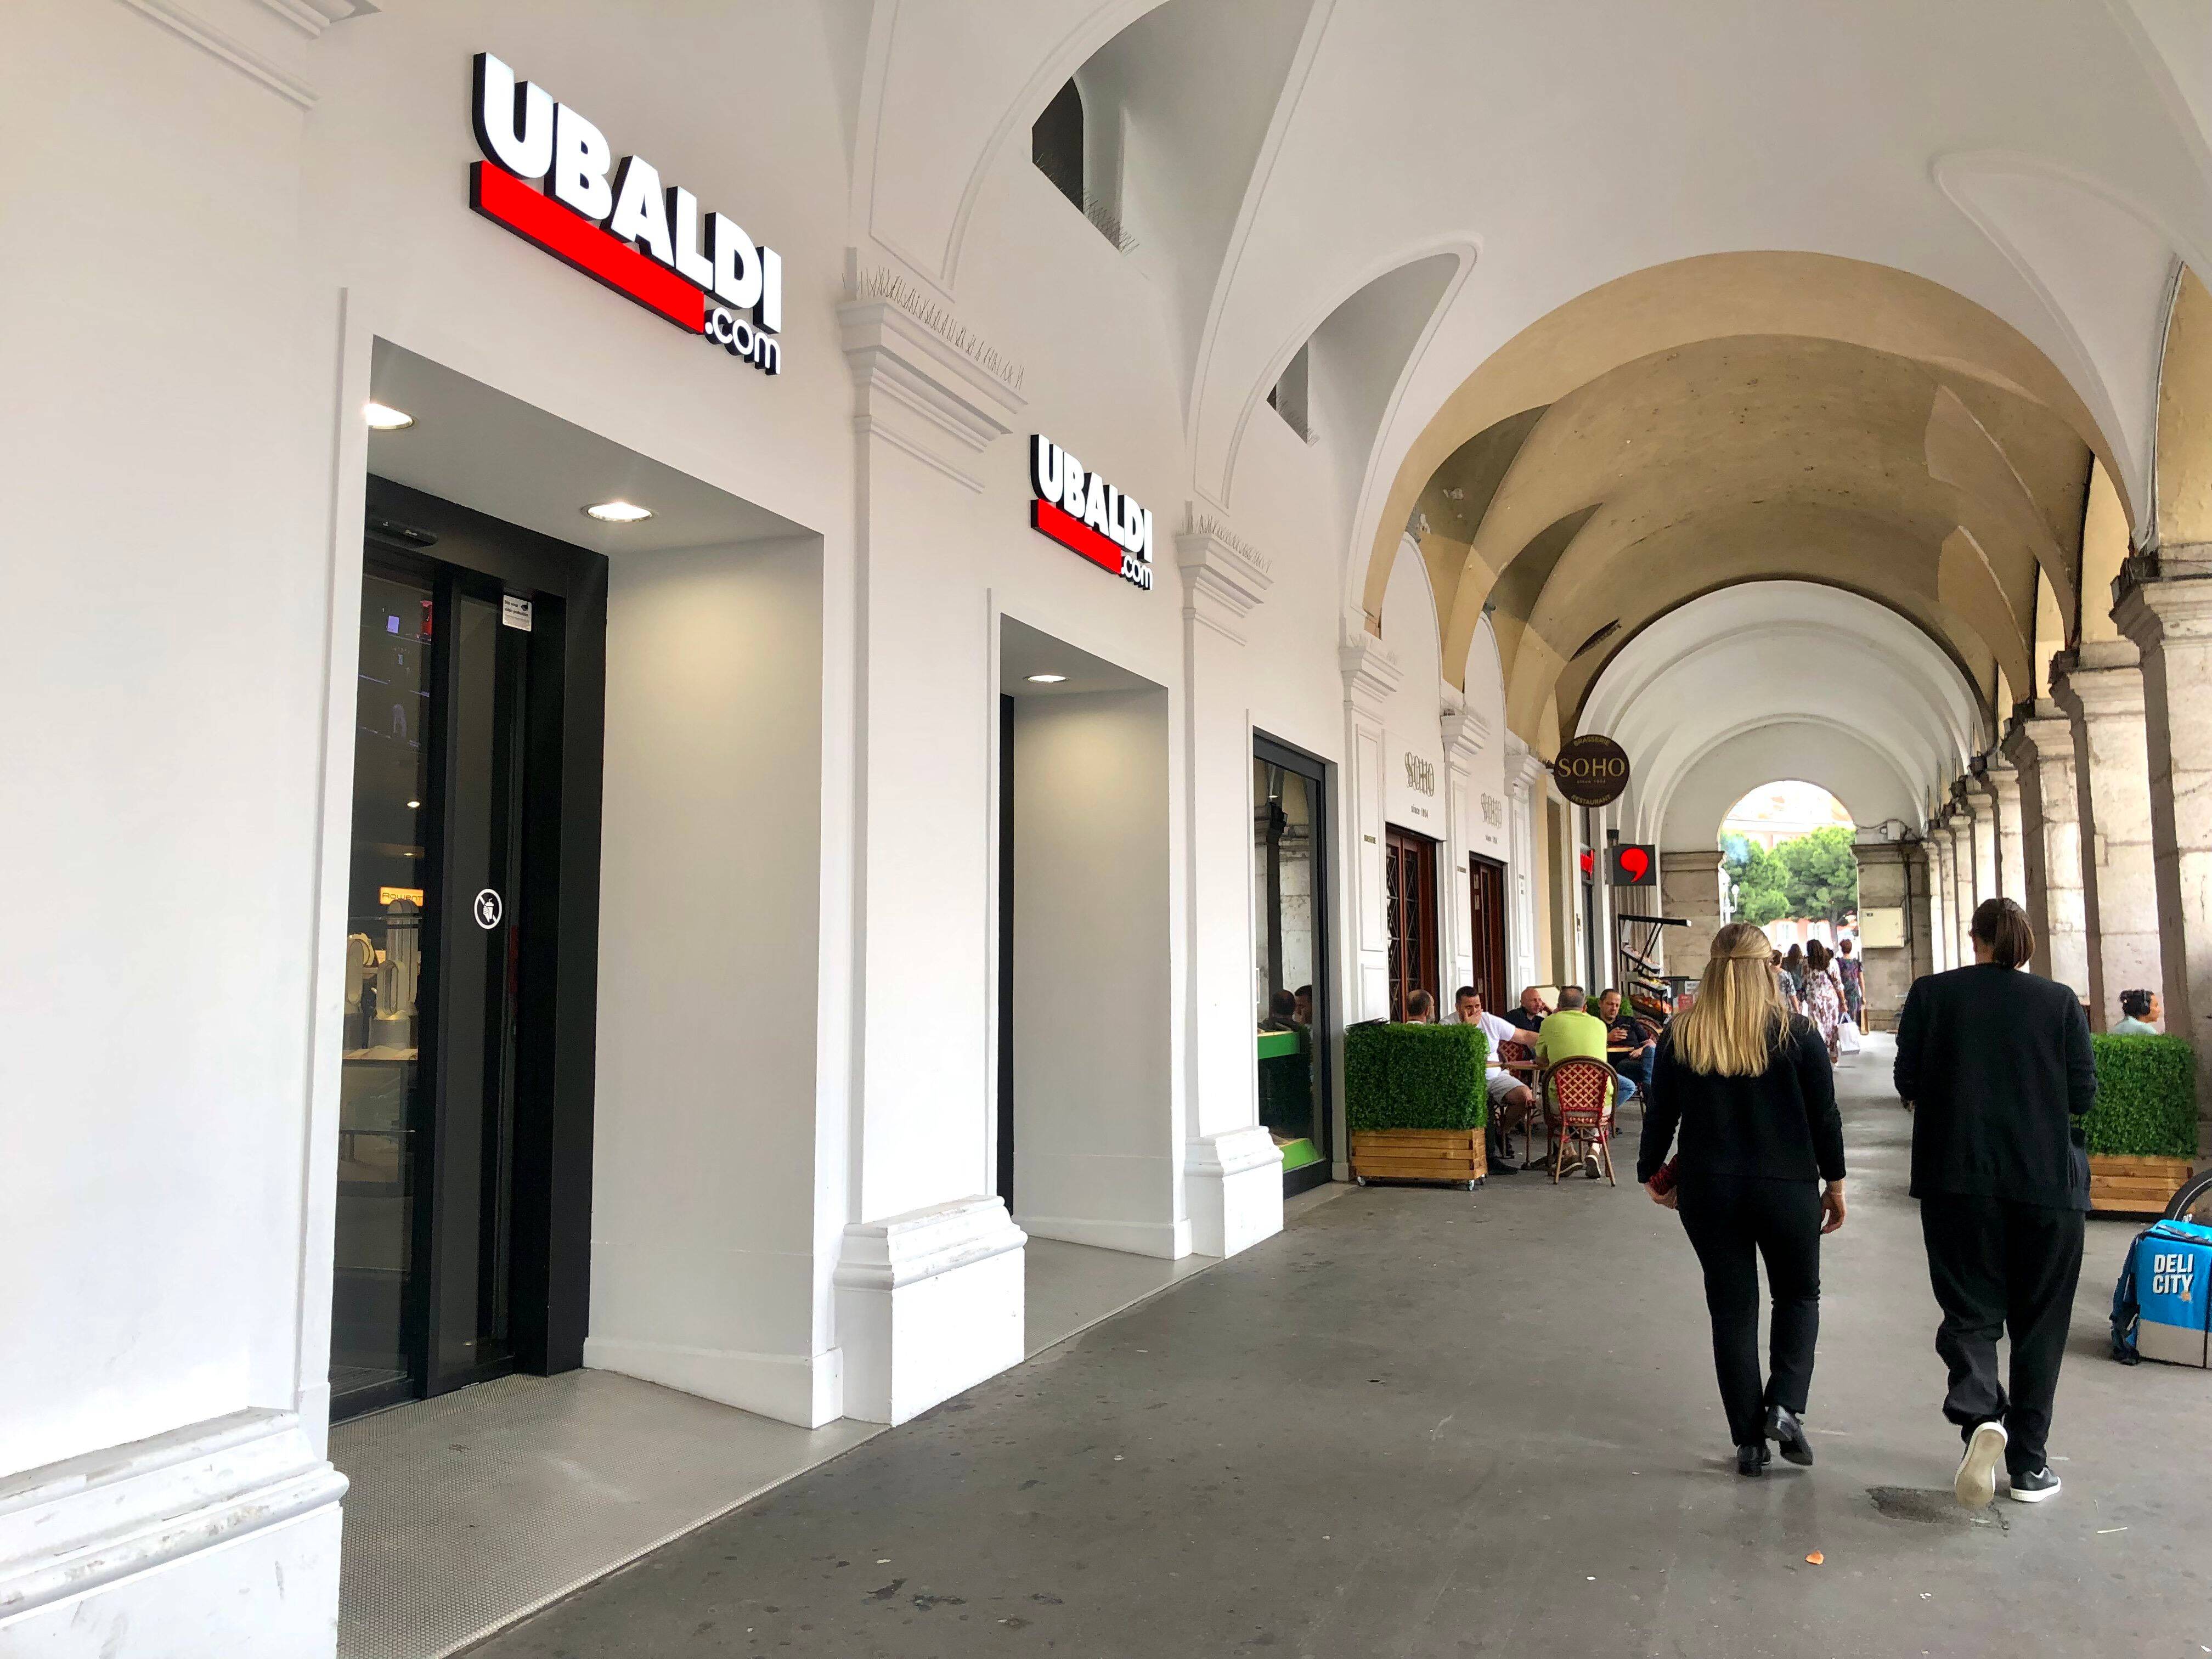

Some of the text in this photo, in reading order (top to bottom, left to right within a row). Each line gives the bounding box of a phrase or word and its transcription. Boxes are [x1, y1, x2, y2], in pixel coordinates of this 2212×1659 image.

[474, 52, 782, 334] UBALDI
[704, 307, 781, 375] .com
[1031, 433, 1153, 563] UBALDI
[1120, 554, 1153, 591] .com
[1404, 751, 1435, 797] SOHO
[1558, 757, 1625, 777] SOHO
[2153, 1274, 2194, 1294] CITY
[2154, 1254, 2194, 1273] DELI
